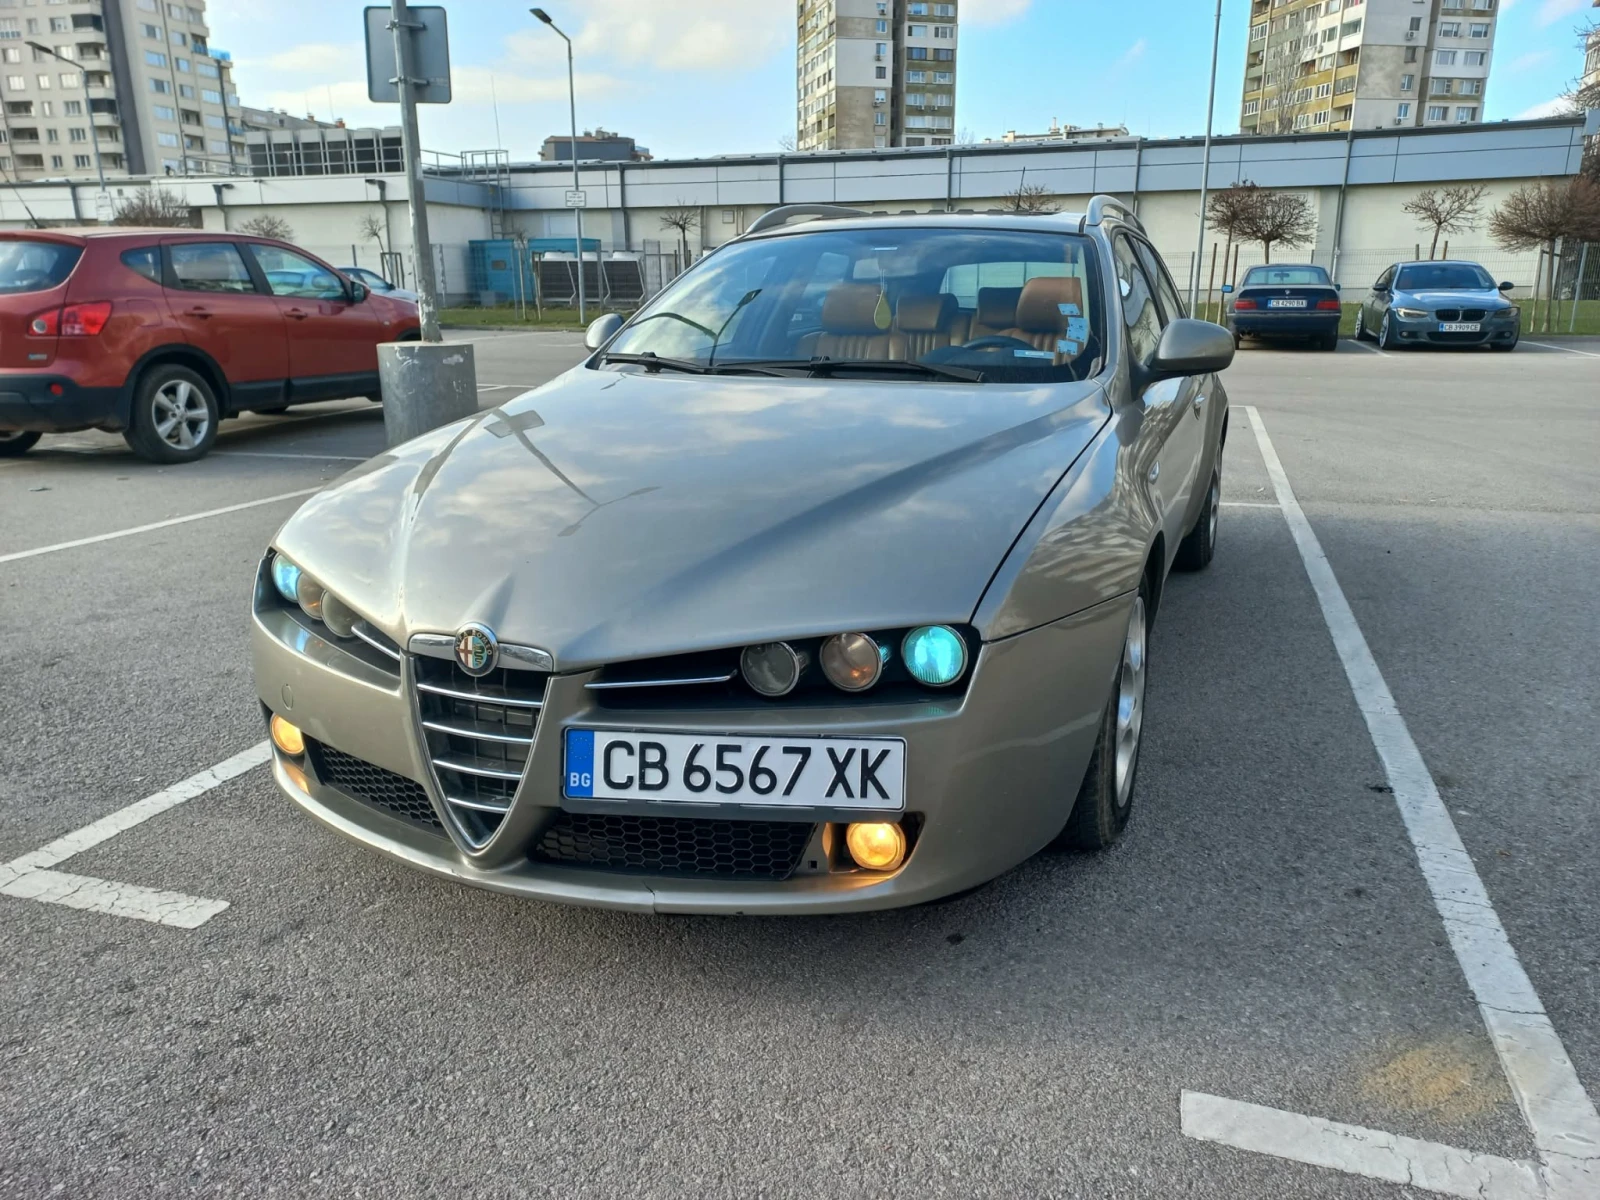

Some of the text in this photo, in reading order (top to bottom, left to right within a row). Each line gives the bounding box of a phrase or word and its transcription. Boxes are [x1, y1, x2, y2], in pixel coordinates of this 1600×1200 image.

[569, 772, 591, 788] BG
[603, 740, 891, 800] CB 6567 XK
